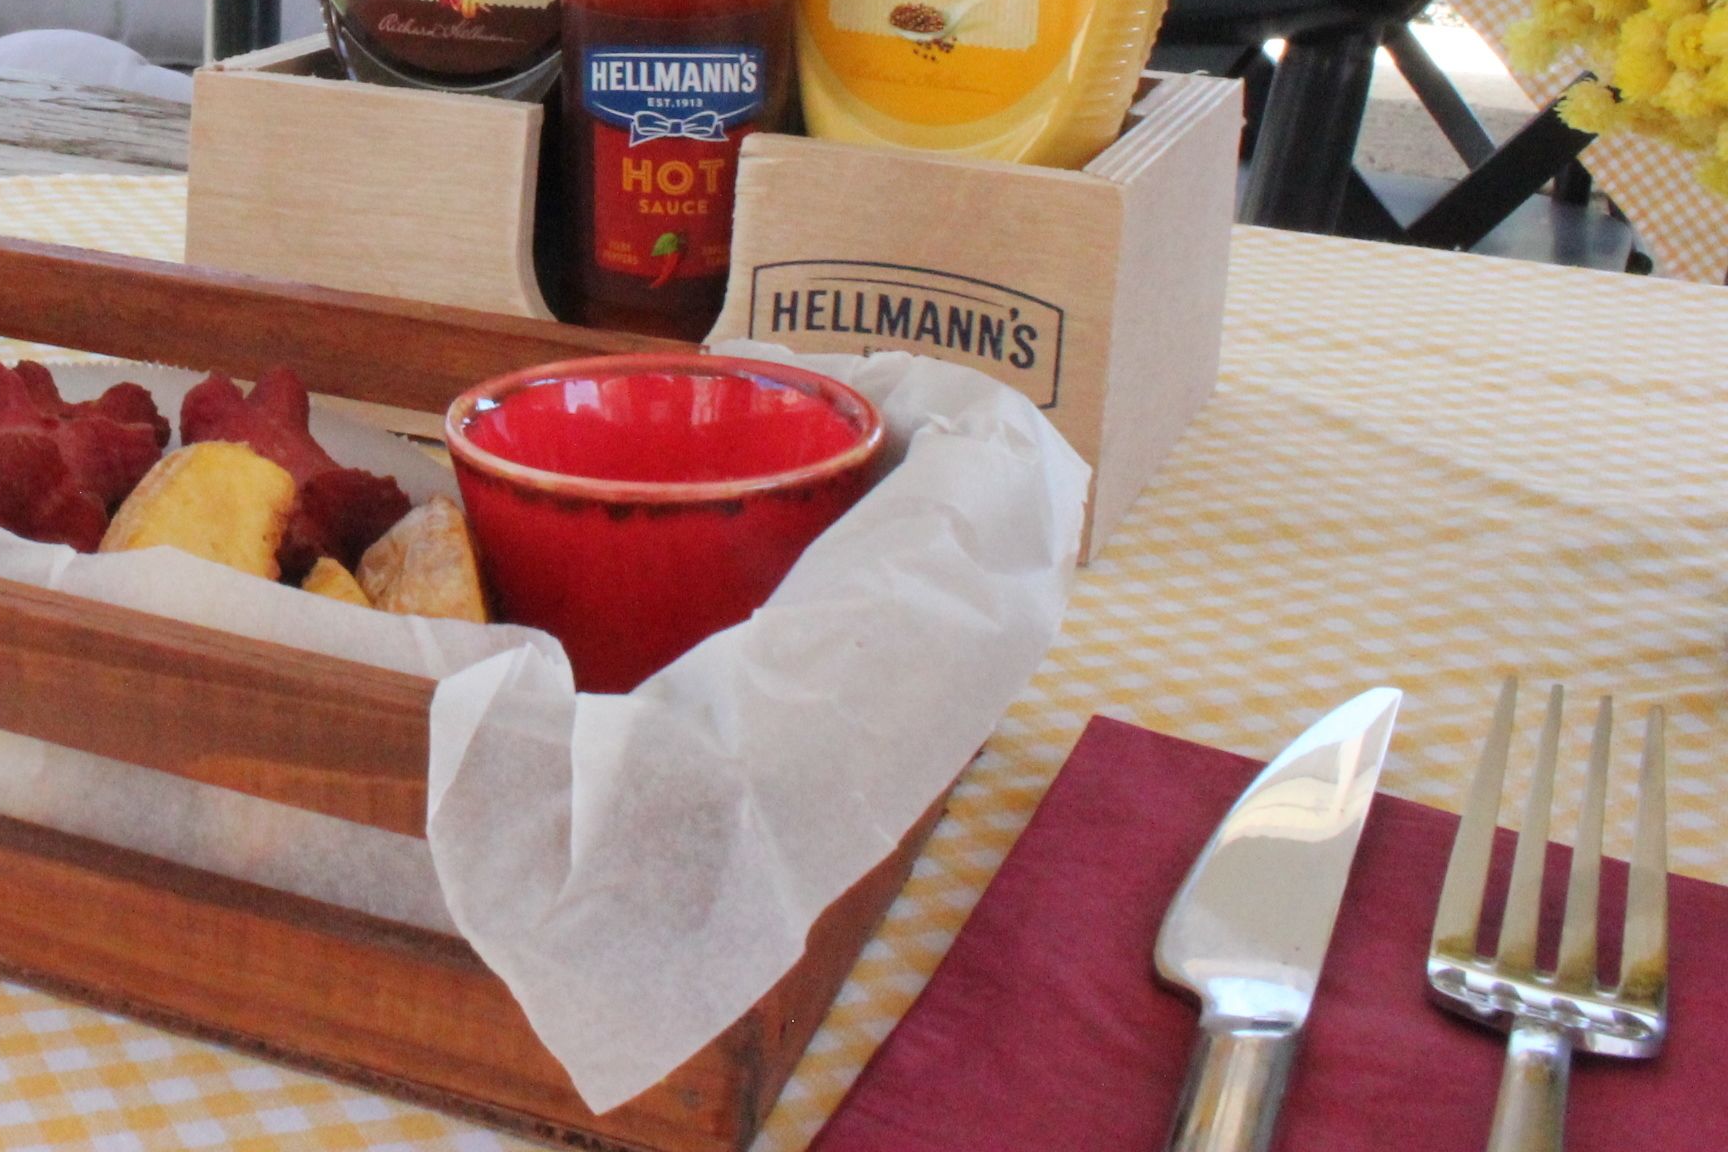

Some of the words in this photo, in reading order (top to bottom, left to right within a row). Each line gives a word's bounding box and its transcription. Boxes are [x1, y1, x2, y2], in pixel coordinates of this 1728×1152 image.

[590, 53, 759, 93] HELLMANN'S
[647, 97, 704, 108] EST.1913
[621, 158, 726, 194] HOT
[639, 199, 709, 215] SAUCE
[772, 289, 1039, 369] HELLMANN'S
